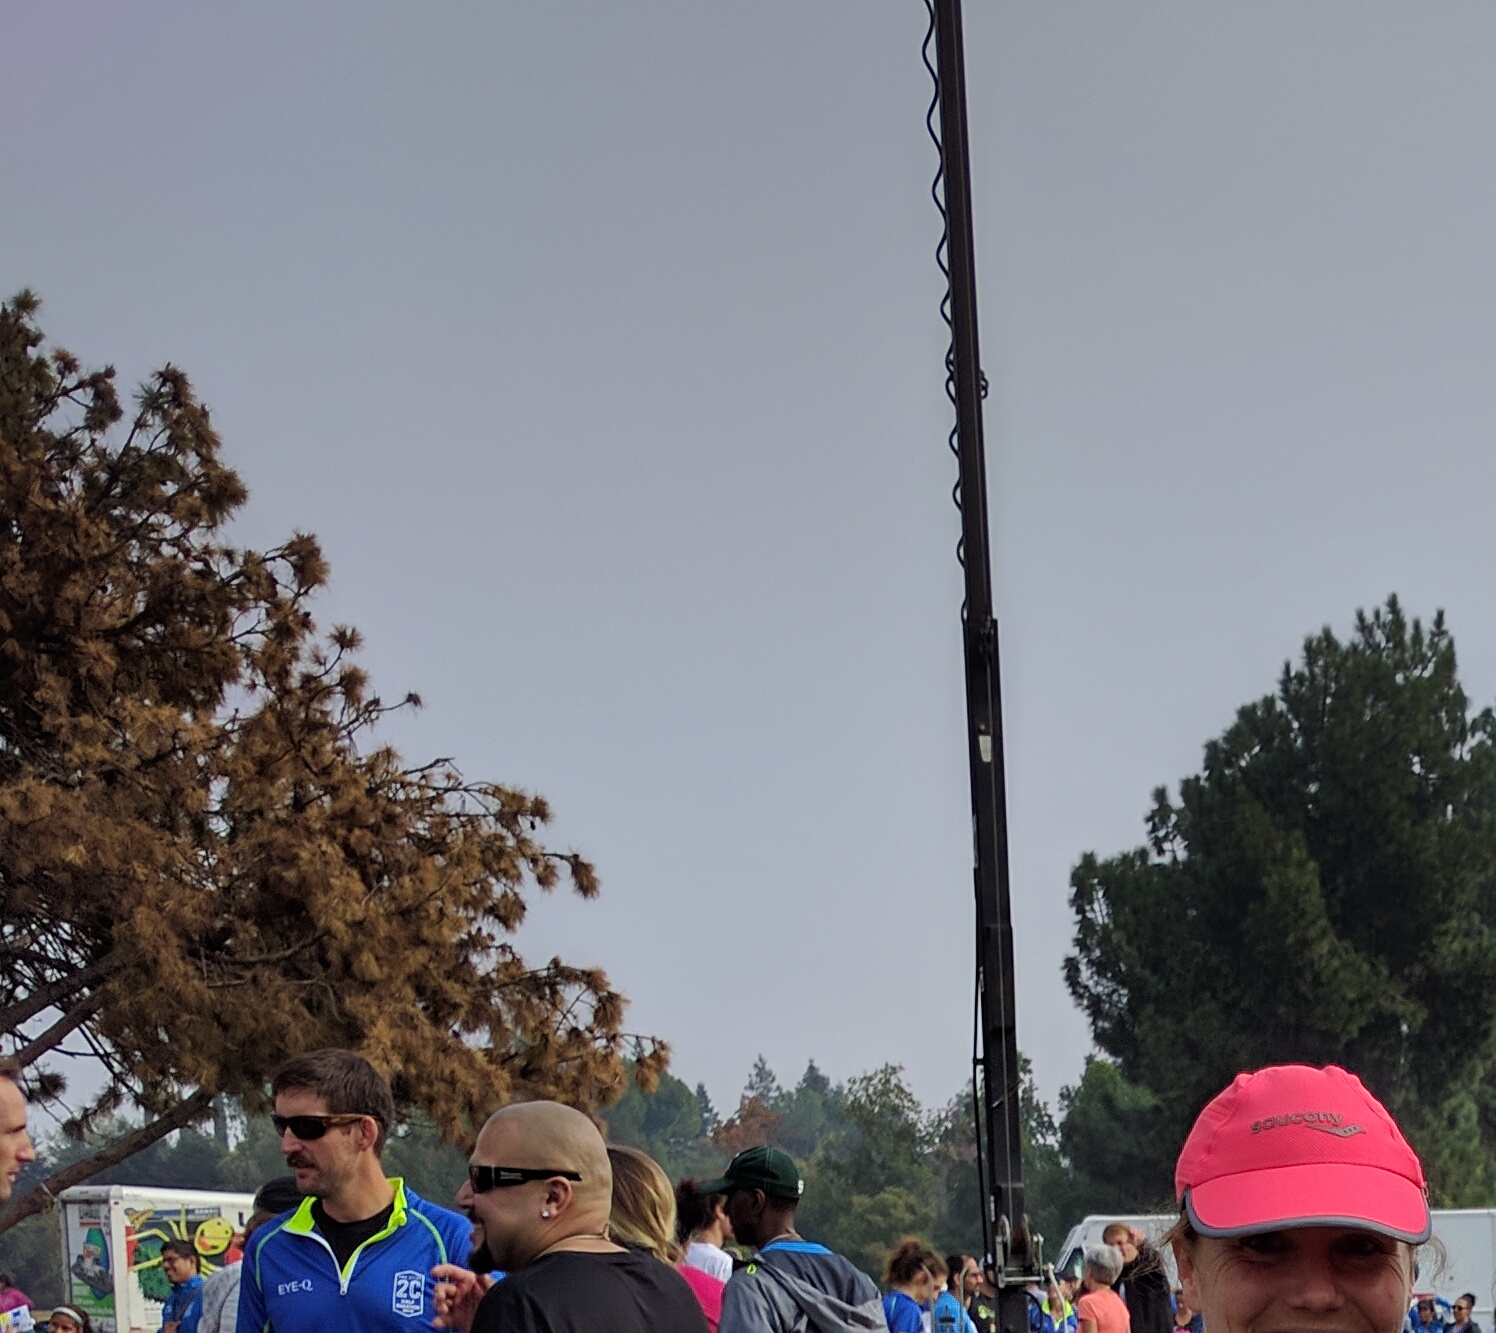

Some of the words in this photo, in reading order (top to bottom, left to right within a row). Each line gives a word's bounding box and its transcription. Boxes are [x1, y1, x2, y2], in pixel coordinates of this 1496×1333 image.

[1250, 1111, 1342, 1135] saucony
[277, 1279, 313, 1296] EYE-Q
[396, 1279, 421, 1299] 2C
